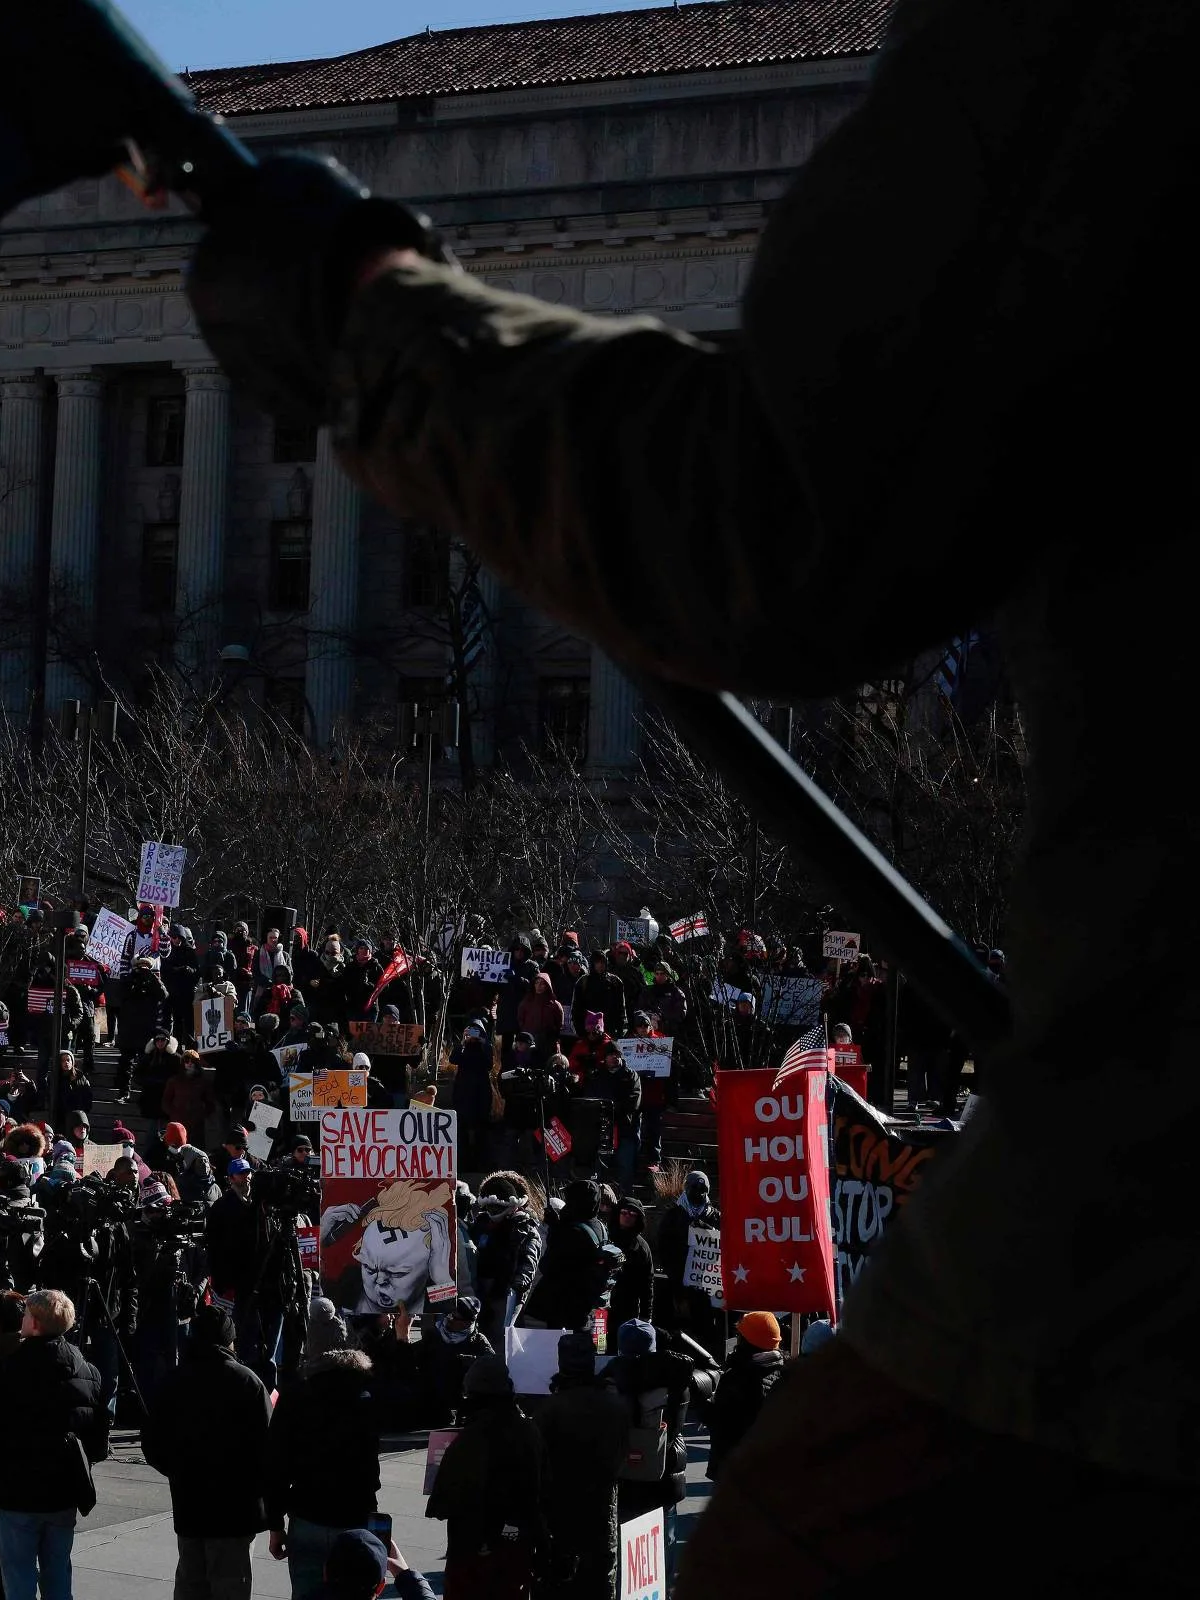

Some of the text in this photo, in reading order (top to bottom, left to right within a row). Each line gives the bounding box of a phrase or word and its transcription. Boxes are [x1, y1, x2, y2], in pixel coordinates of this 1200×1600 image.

[140, 884, 177, 906] BUSSY
[825, 936, 846, 944] DUMP
[466, 949, 510, 966] AMERICA
[479, 962, 490, 972] IS
[201, 1032, 228, 1050] ICE
[319, 1088, 360, 1107] Troble
[754, 1094, 805, 1123] OU
[321, 1111, 453, 1145] SAVE OUR
[321, 1145, 453, 1178] DEMOCRACY!
[758, 1174, 809, 1204] OU
[834, 1179, 893, 1246] STOP
[744, 1216, 814, 1243] RUL
[305, 1245, 317, 1254] DC
[627, 1525, 660, 1595] MELT
